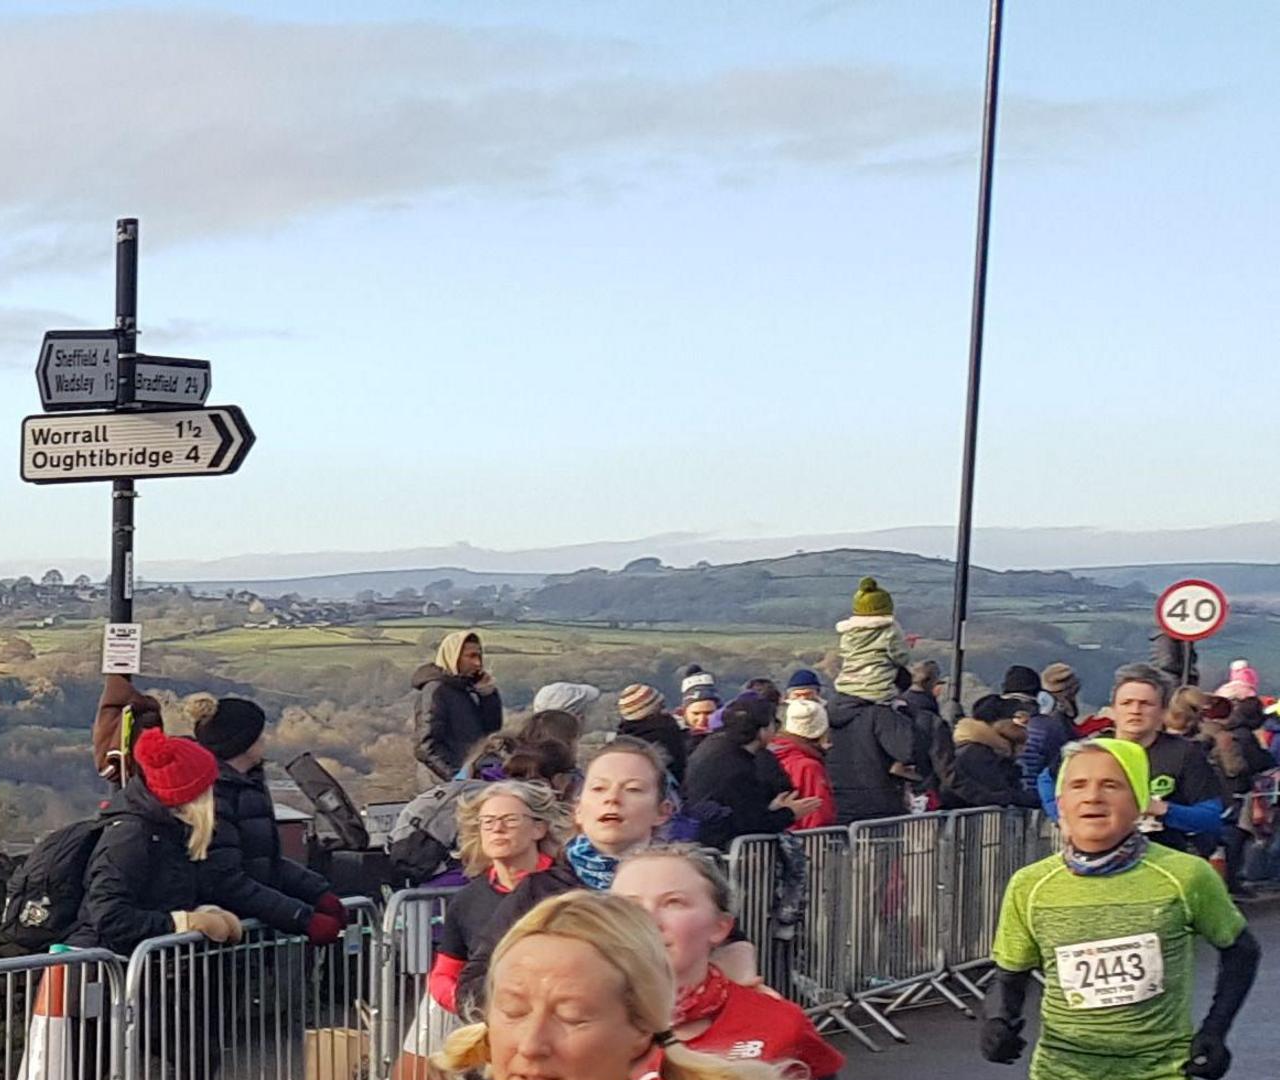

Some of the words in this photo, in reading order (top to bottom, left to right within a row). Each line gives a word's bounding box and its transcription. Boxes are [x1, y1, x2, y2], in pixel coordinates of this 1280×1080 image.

[55, 349, 97, 367] Sheffield
[103, 348, 110, 366] 4
[55, 373, 95, 394] Wadsley
[135, 373, 179, 393] Bradfield
[31, 425, 109, 445] Worrall
[32, 447, 173, 471] Oughtibridge
[184, 445, 201, 463] 4
[1166, 598, 1217, 622] 40
[1075, 953, 1145, 988] 2443
